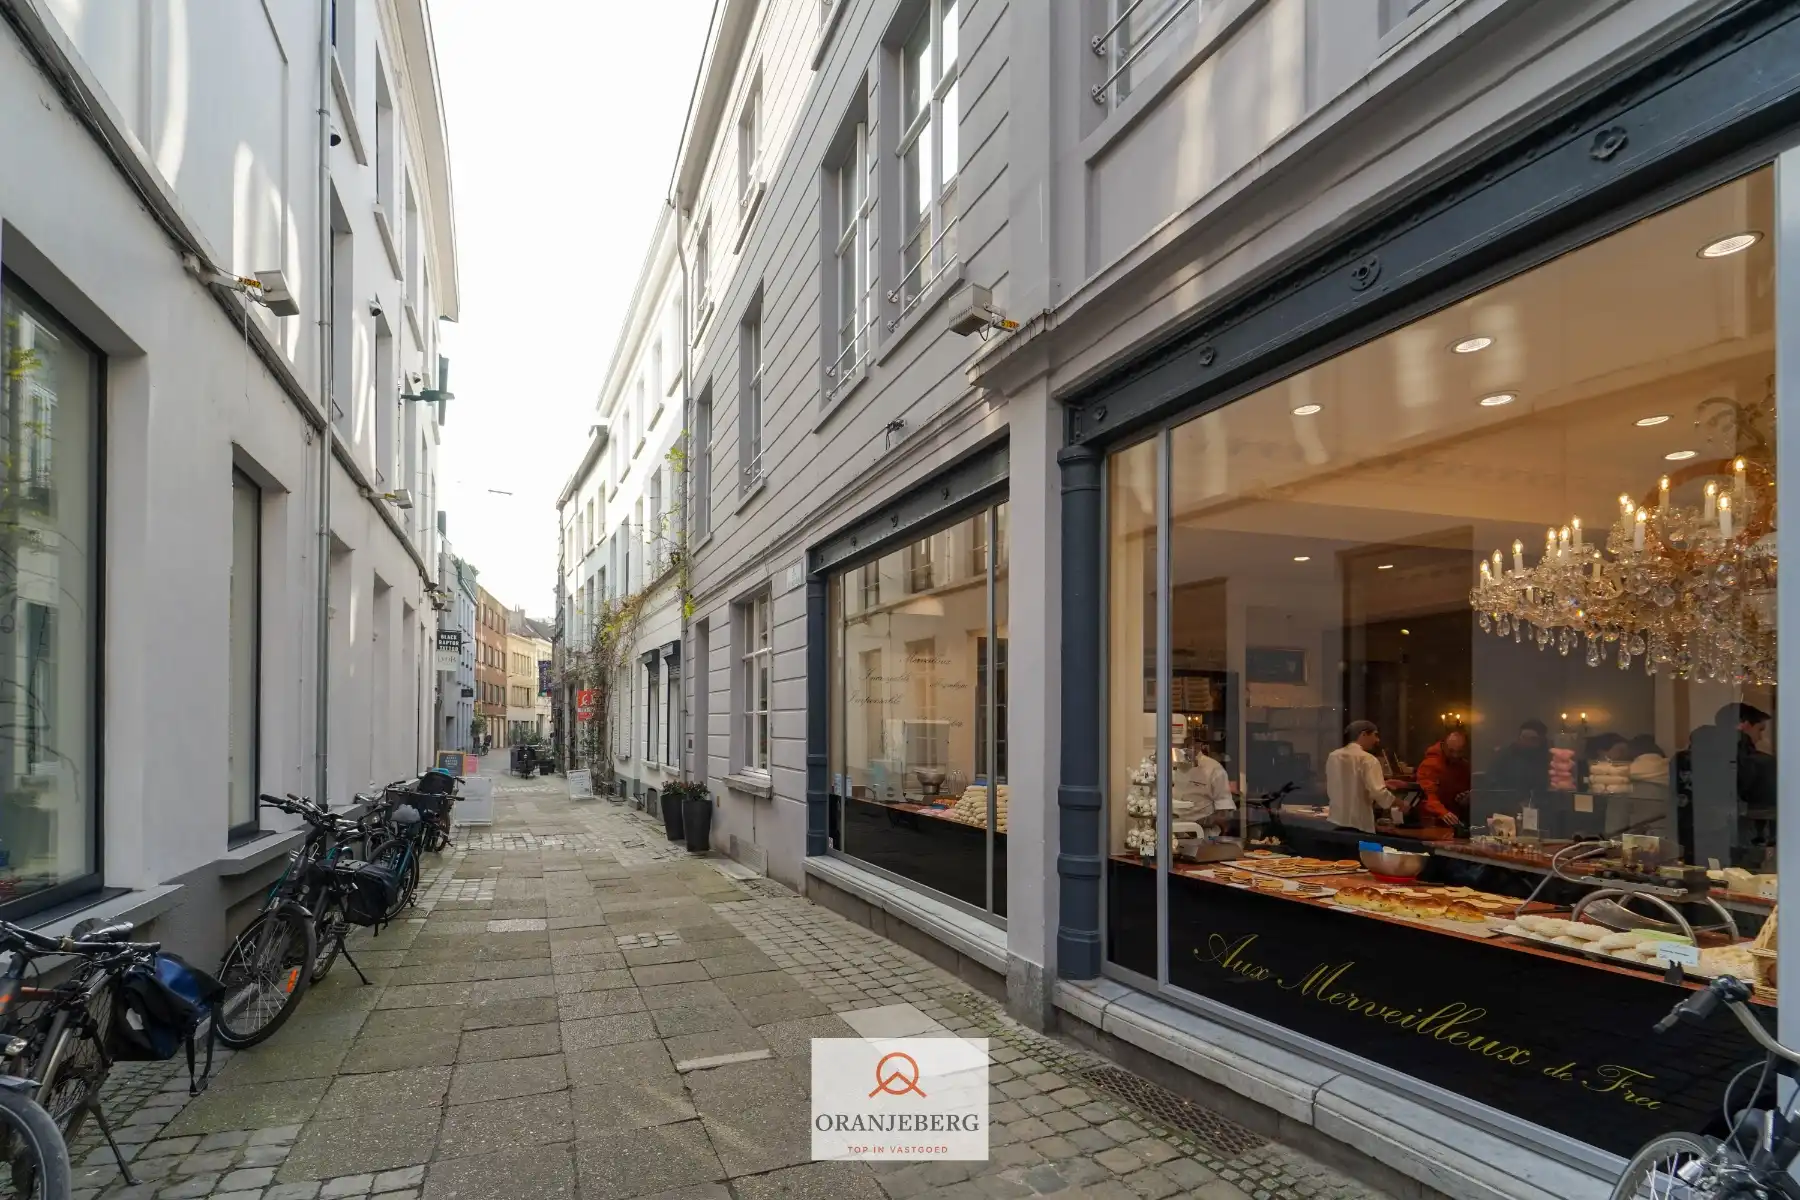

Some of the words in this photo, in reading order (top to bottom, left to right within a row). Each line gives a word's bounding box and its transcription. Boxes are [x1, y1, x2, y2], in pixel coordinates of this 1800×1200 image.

[1193, 933, 1269, 981] Aux
[1276, 961, 1530, 1065] Merveilleux
[1543, 1062, 1577, 1081] de
